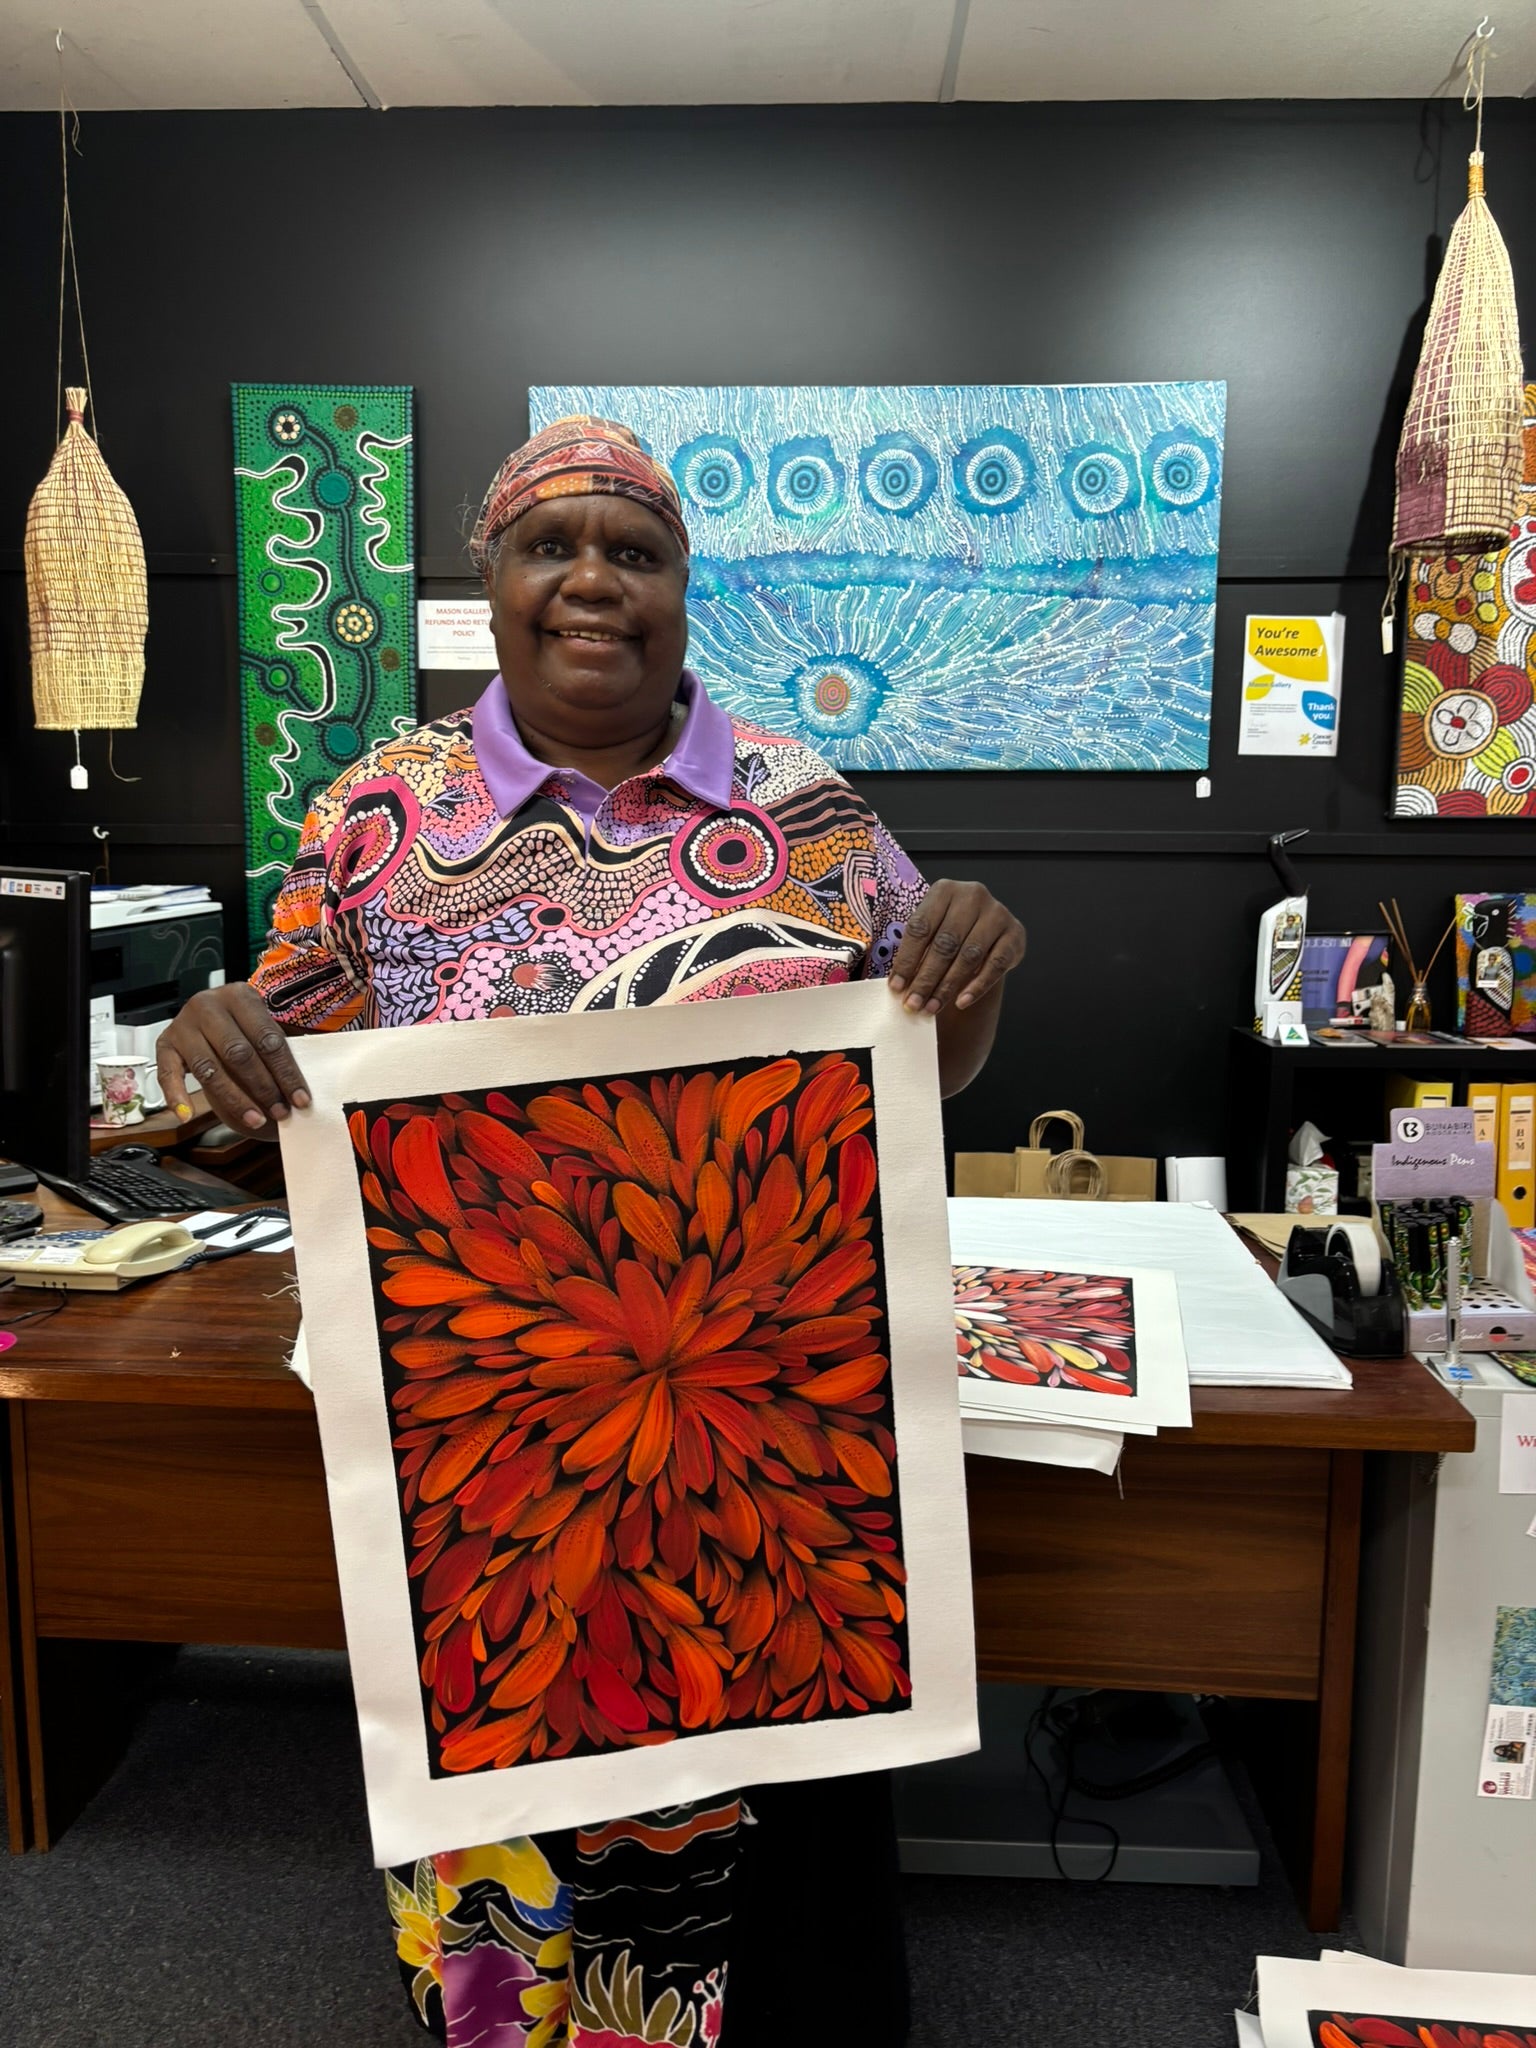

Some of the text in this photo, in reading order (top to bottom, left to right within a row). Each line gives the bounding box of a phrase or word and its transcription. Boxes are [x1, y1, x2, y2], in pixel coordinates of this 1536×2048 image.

[1254, 644, 1323, 657] Awesome!
[1307, 702, 1335, 711] Thank
[1516, 1142, 1525, 1150] M
[1392, 1154, 1447, 1170] Indigenous
